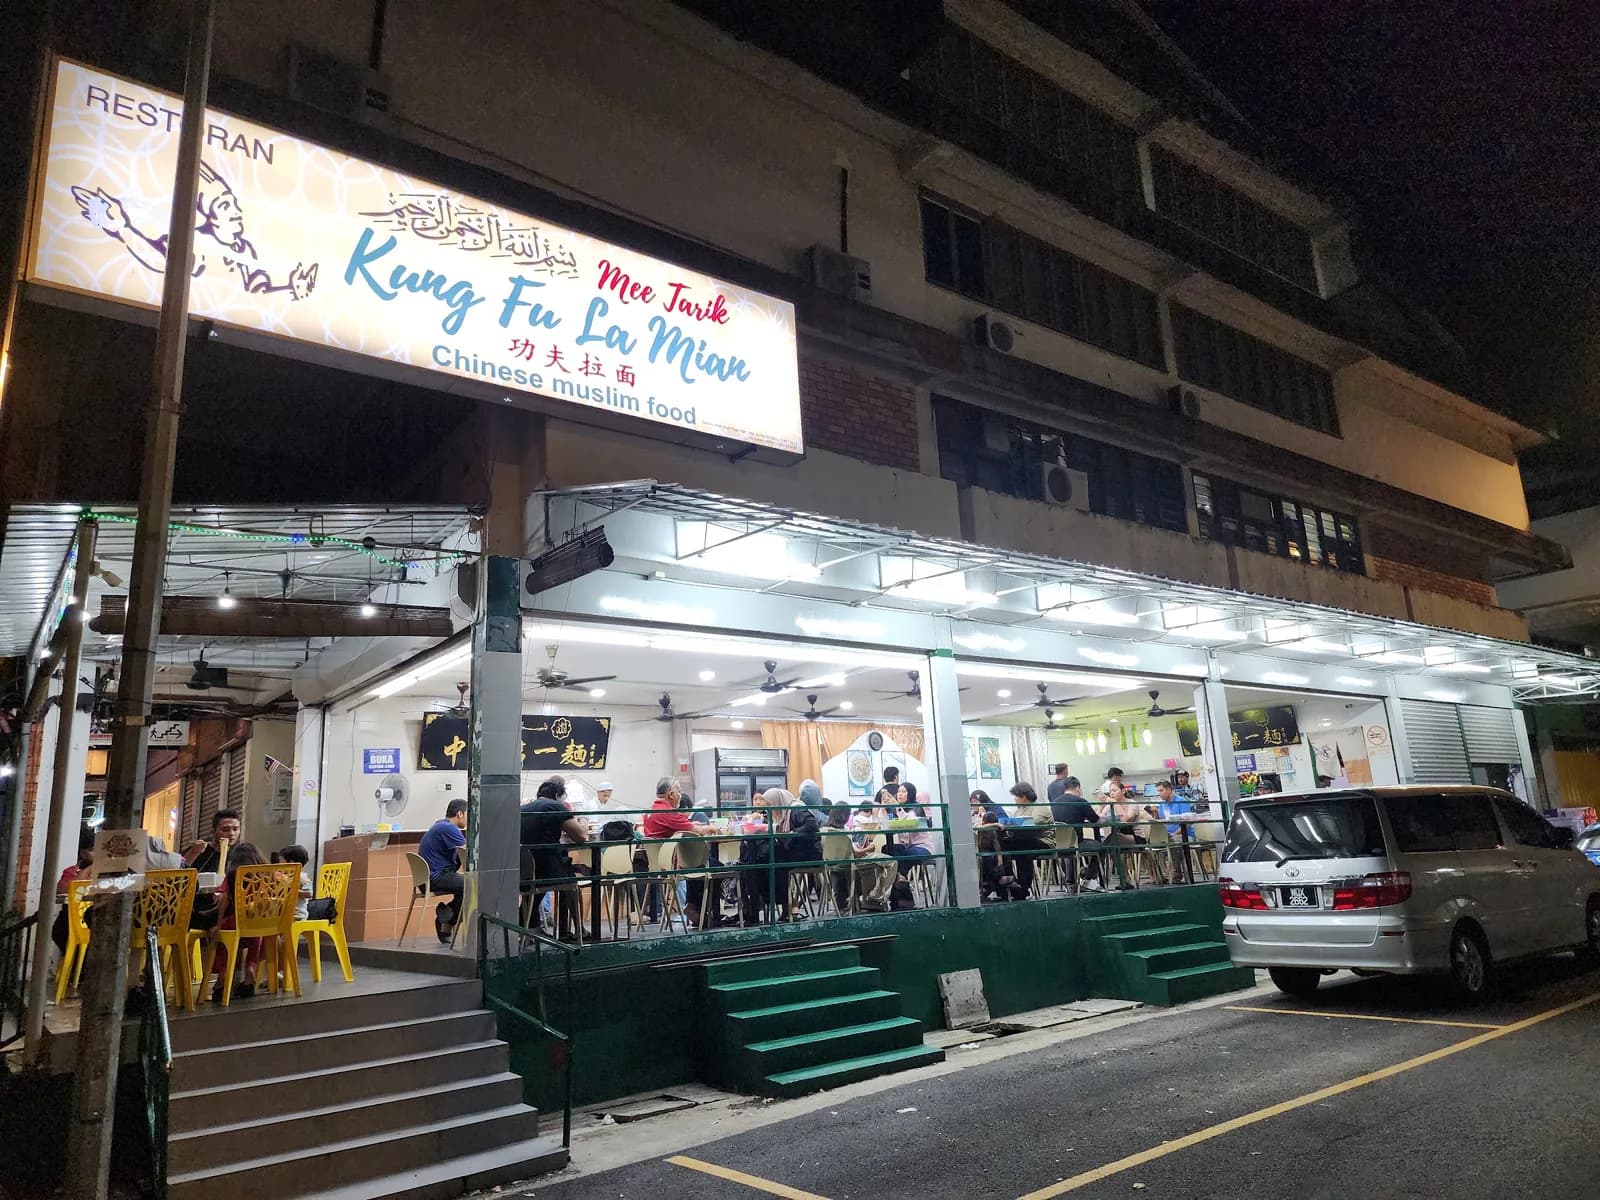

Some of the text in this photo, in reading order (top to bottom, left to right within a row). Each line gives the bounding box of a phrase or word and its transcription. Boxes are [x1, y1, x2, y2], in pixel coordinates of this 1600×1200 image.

[86, 84, 275, 165] RESTRAN
[344, 227, 751, 384] Kung Fu La Mian
[598, 259, 730, 325] Mee Tarik
[432, 345, 697, 426] Chinese muslim food
[508, 337, 637, 388] 功夫拉面
[370, 754, 394, 765] BUKA
